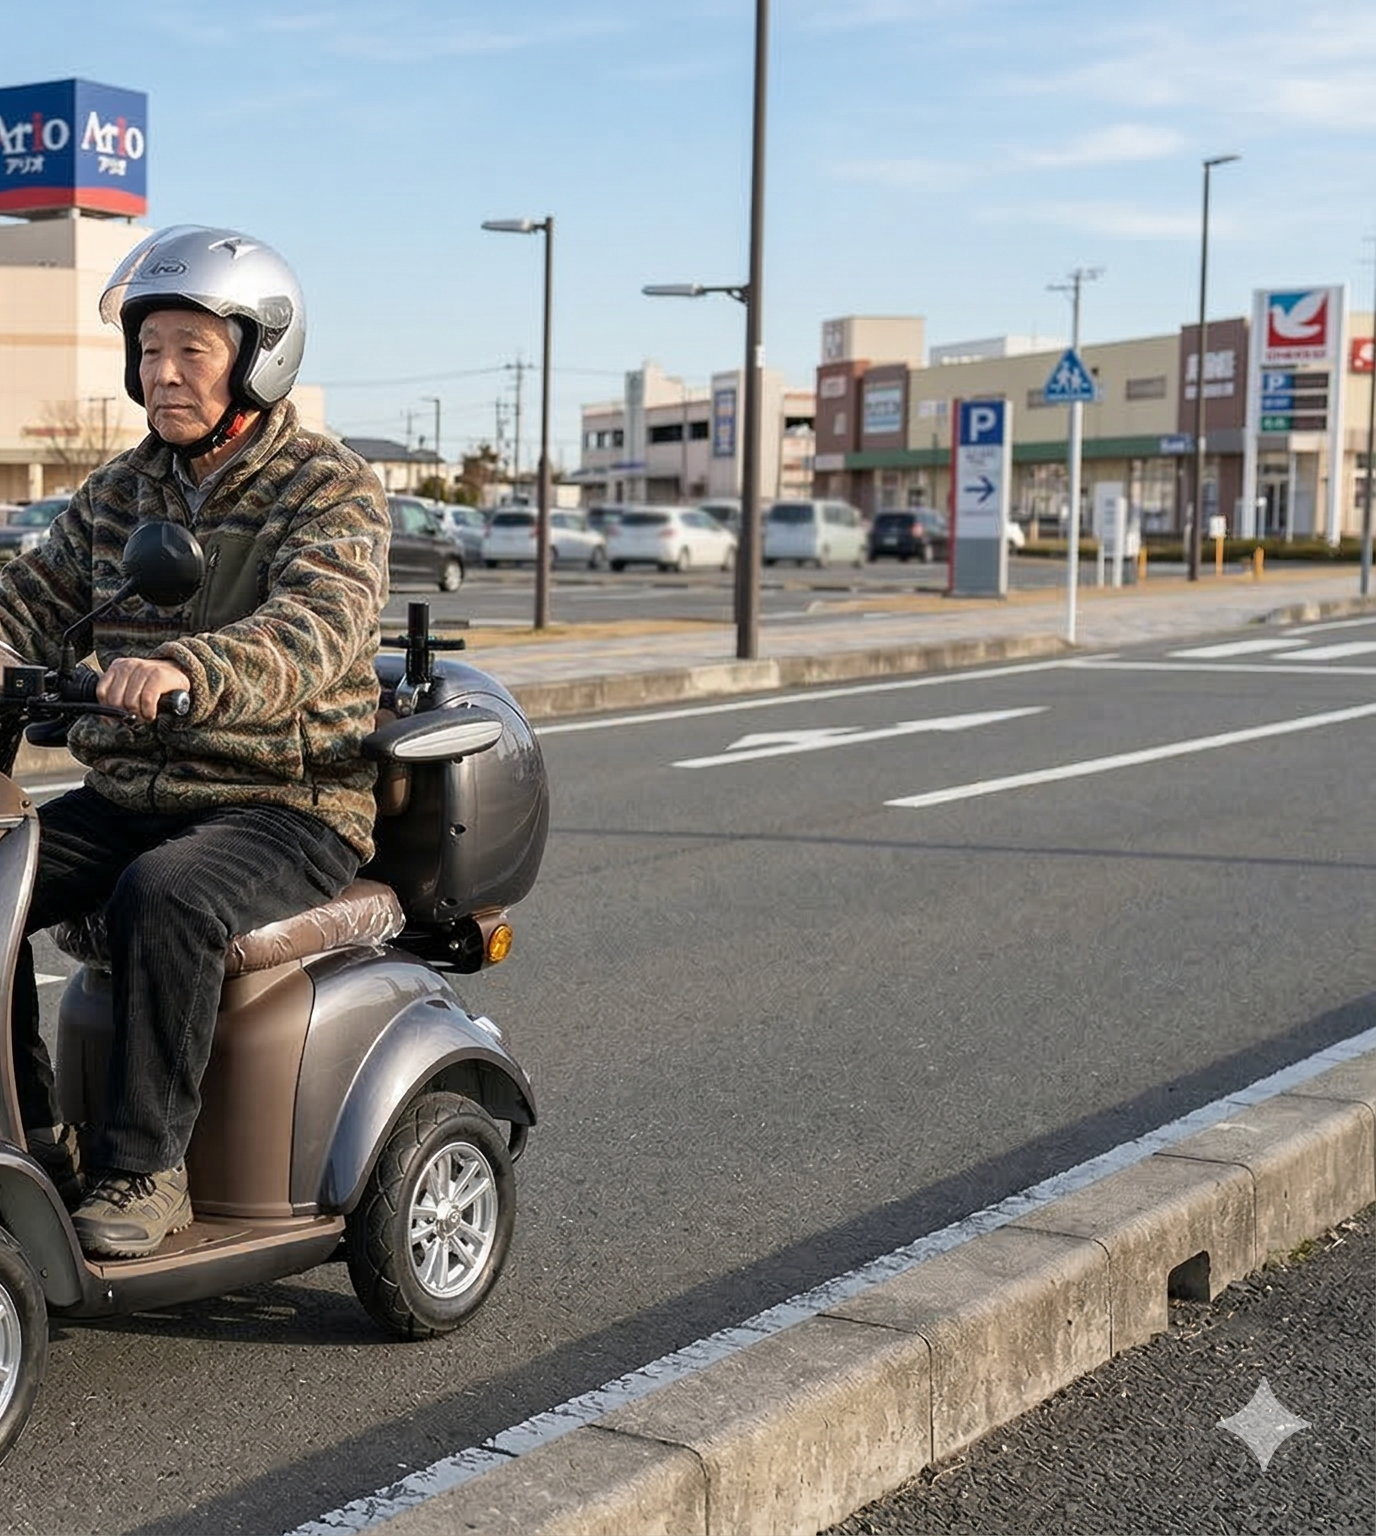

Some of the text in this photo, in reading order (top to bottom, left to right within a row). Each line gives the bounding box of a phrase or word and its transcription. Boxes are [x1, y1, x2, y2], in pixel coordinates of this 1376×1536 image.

[81, 111, 145, 159] Ario
[6, 155, 45, 175] アリオ
[969, 406, 997, 443] P
